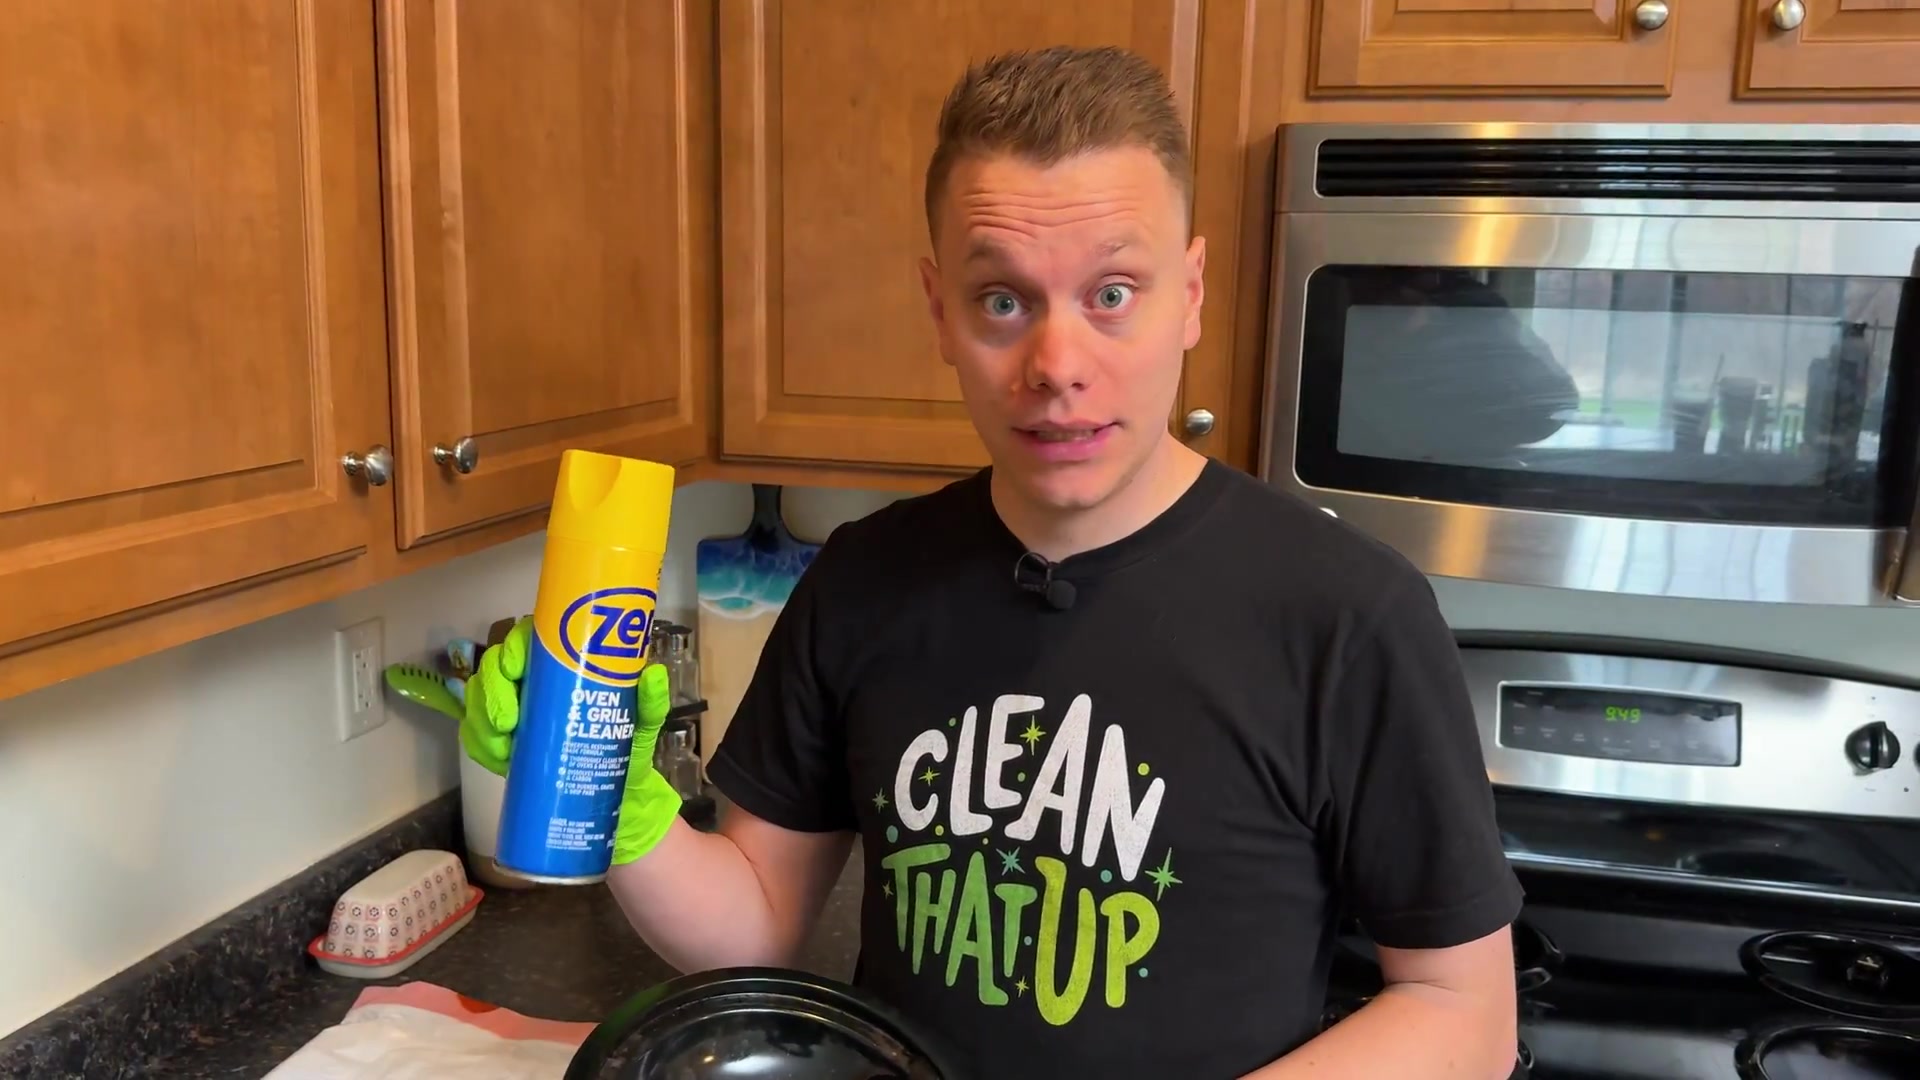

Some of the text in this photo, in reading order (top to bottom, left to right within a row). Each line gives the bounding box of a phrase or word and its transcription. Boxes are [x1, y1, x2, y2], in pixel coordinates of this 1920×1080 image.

[571, 689, 621, 707] OVEN
[568, 705, 631, 724] & GRILL
[565, 722, 635, 740] CLEANER
[895, 693, 1165, 882] CLEAN
[881, 842, 1161, 1026] THAT UP
